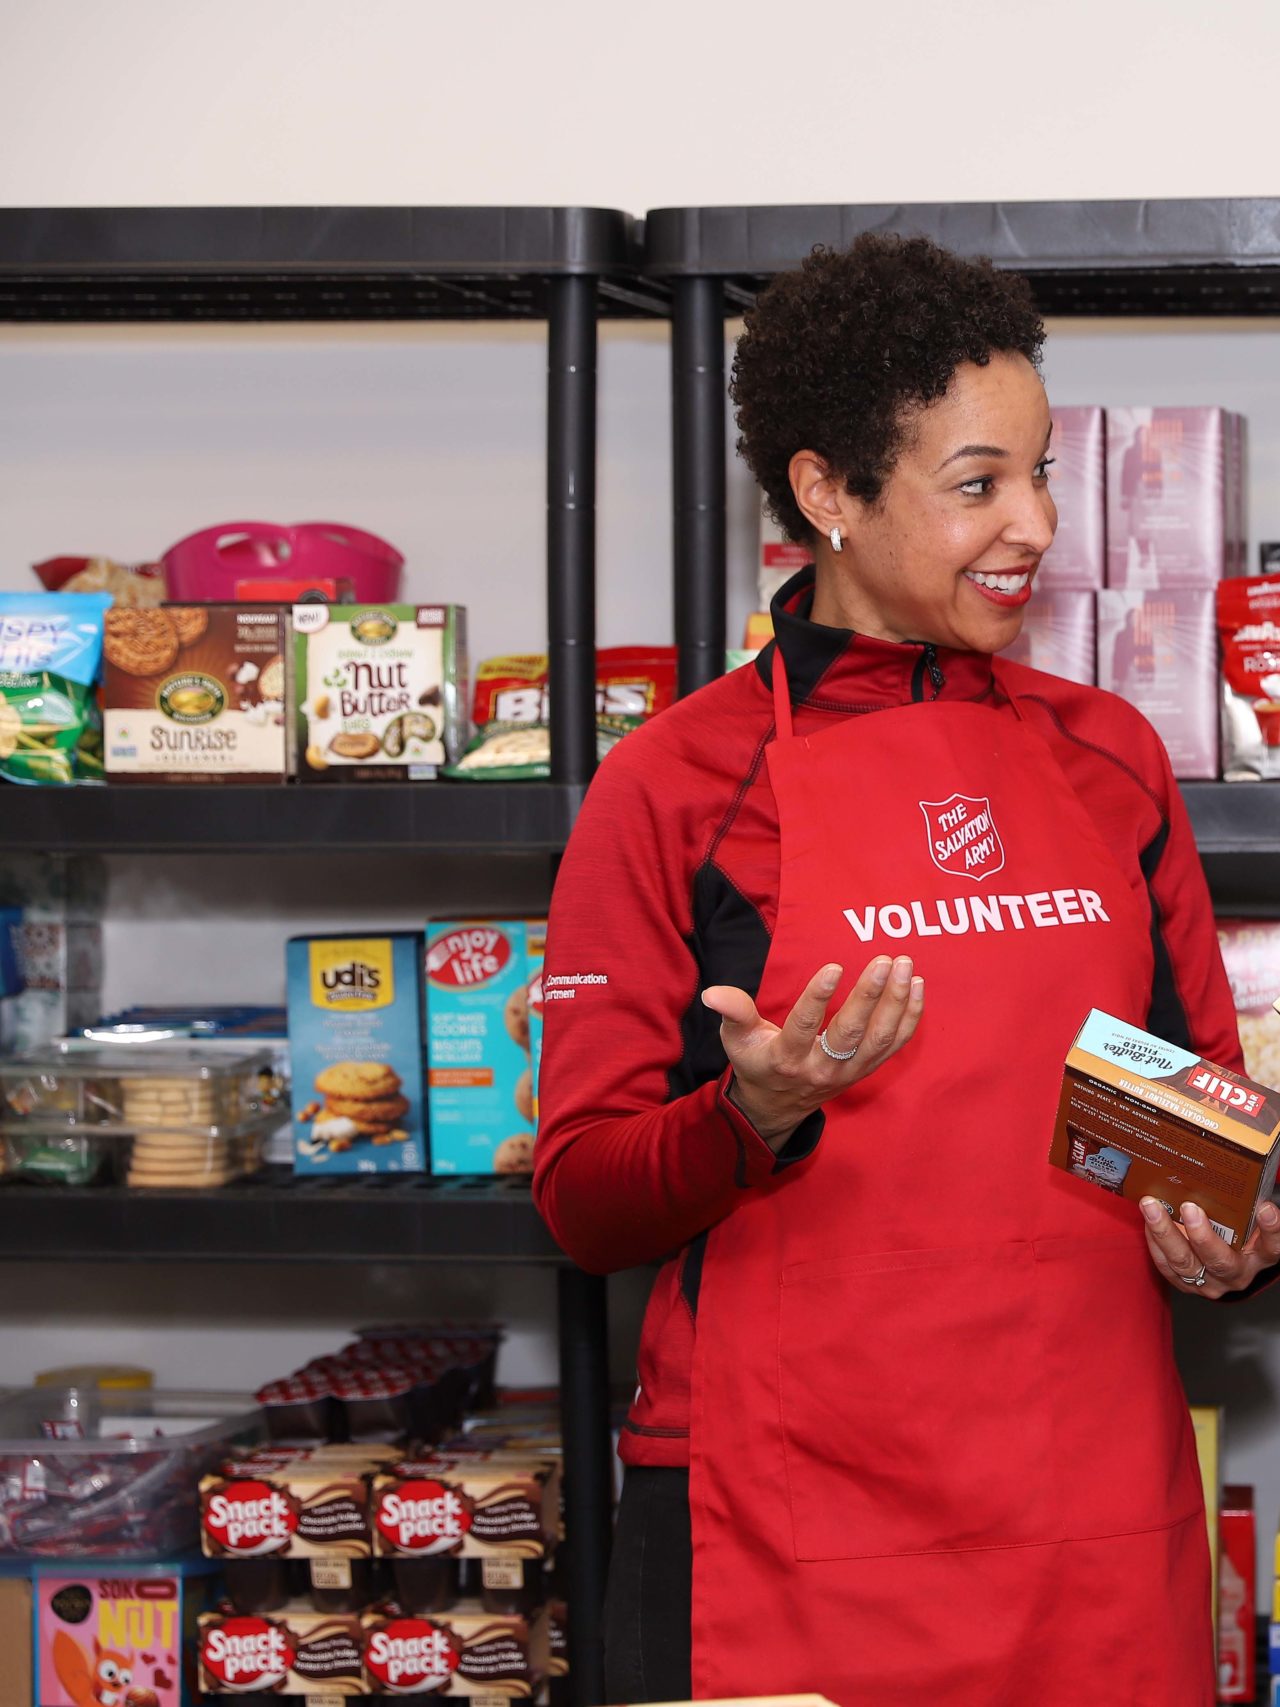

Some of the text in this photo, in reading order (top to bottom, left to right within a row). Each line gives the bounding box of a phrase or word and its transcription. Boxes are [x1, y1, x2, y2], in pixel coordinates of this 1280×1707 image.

[938, 802, 967, 832] THE
[935, 809, 991, 862] SALVATION
[964, 832, 996, 870] ARMY
[843, 888, 1111, 943] VOLUNTEER
[1101, 1041, 1175, 1072] Nut Butter
[1123, 1040, 1158, 1057] FILLED
[1088, 1079, 1117, 1095] ORGANIC
[1118, 1078, 1144, 1095] BUTTER
[1144, 1090, 1181, 1112] HAZELNUT
[1192, 1071, 1249, 1107] CLIF
[1119, 1104, 1130, 1112] NEW
[1181, 1106, 1220, 1130] CHOCOLATE
[207, 1491, 290, 1528] Snack
[380, 1491, 462, 1527] Snack
[227, 1516, 290, 1546] pack
[399, 1516, 461, 1545] pack
[98, 1600, 179, 1649] NUT
[206, 1627, 287, 1662] Snack
[368, 1630, 450, 1665] Snack
[224, 1652, 286, 1681] pack
[387, 1656, 450, 1684] pack
